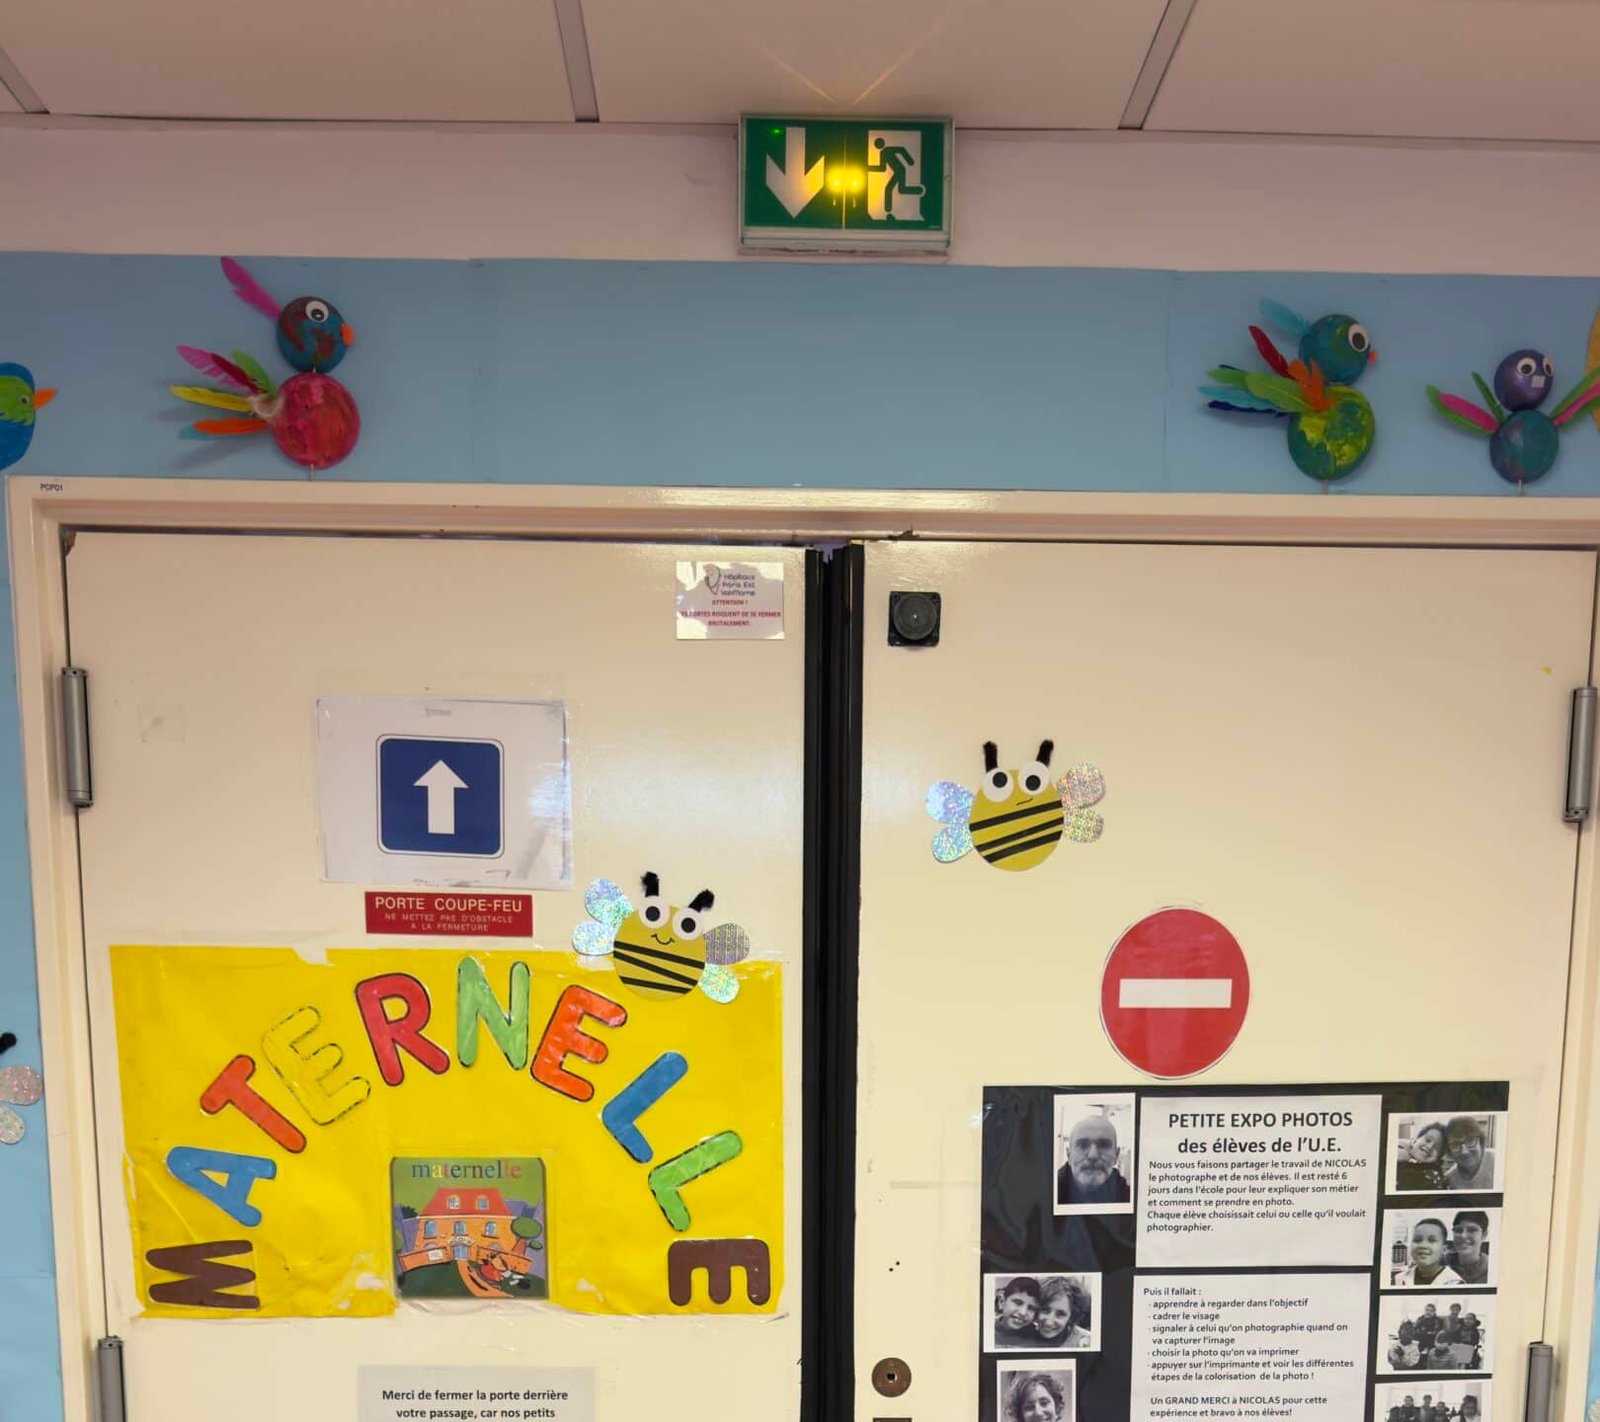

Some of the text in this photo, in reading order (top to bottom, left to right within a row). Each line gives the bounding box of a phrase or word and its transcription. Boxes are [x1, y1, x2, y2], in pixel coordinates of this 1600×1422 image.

[375, 896, 522, 912] PORTE COUPE-FEU
[384, 913, 513, 923] NE METTEZ PAS D'OBSTACLE
[422, 923, 432, 931] LA
[437, 923, 489, 932] FERMETURE
[1168, 1111, 1353, 1128] PETITE EXPO PHOTOS
[146, 956, 771, 1309] MATERNELLE
[1178, 1136, 1342, 1154] des élèves de l'U.E.
[411, 1159, 522, 1179] maternelle
[1149, 1160, 1173, 1169] Nous
[1197, 1160, 1229, 1169] faisons
[1230, 1160, 1270, 1171] partager
[1271, 1160, 1280, 1168] le
[1282, 1159, 1310, 1168] travail
[1312, 1159, 1323, 1168] de
[1324, 1158, 1367, 1168] NICOLAS
[1148, 1172, 1157, 1181] le
[1159, 1172, 1217, 1183] photographe
[1218, 1173, 1228, 1181] et
[1230, 1172, 1241, 1181] de
[1261, 1172, 1291, 1181] élèves.
[1317, 1172, 1340, 1180] resté
[1341, 1172, 1348, 1180] 6
[1147, 1186, 1170, 1196] jours
[1172, 1185, 1194, 1194] dans
[1195, 1185, 1224, 1194] l'école
[1226, 1186, 1247, 1195] pour
[1249, 1185, 1266, 1194] leur
[1268, 1184, 1310, 1195] expliquer
[1329, 1184, 1359, 1192] métier
[1147, 1199, 1157, 1207] et
[1159, 1199, 1202, 1207] comment
[1215, 1198, 1251, 1208] prendre
[1265, 1198, 1294, 1208] photo.
[1147, 1210, 1181, 1220] Chaque
[1183, 1210, 1206, 1219] élève
[1208, 1210, 1254, 1219] choisissait
[1256, 1209, 1277, 1218] celui
[1291, 1209, 1313, 1218] celle
[1335, 1209, 1366, 1218] voulait
[1147, 1222, 1214, 1233] photographier.
[1143, 1287, 1162, 1296] Puis
[1171, 1287, 1197, 1296] fallait
[1153, 1299, 1199, 1309] apprendre
[1207, 1299, 1245, 1310] regarder
[1247, 1299, 1268, 1308] dans
[1152, 1312, 1220, 1321] cadrer le visage
[1152, 1324, 1187, 1334] signaler
[1196, 1324, 1216, 1332] celui
[1244, 1323, 1305, 1333] photographie
[1306, 1323, 1335, 1333] quand
[1164, 1337, 1201, 1346] capturer
[1151, 1348, 1181, 1357] choisir
[1182, 1348, 1190, 1356] la
[1192, 1348, 1218, 1358] photo
[1259, 1347, 1300, 1357] imprimer
[1151, 1362, 1187, 1371] appuyer
[1273, 1360, 1290, 1368] voir
[1292, 1360, 1304, 1368] les
[1305, 1359, 1354, 1368] différentes
[1151, 1372, 1180, 1382] étapes
[1182, 1372, 1193, 1381] de
[1195, 1372, 1203, 1380] la
[1204, 1372, 1256, 1381] colorisation
[1260, 1372, 1271, 1380] de
[1273, 1372, 1281, 1380] la
[1282, 1372, 1309, 1381] photo
[382, 1389, 568, 1403] Merci de fermer la porte derrière
[1150, 1397, 1163, 1405] Un
[1165, 1396, 1199, 1405] GRAND
[1201, 1396, 1230, 1405] MERCI
[1239, 1396, 1281, 1404] NICOLAS
[1282, 1397, 1303, 1406] pour
[1304, 1396, 1328, 1404] cette
[396, 1407, 556, 1420] votre passage, car nos petits
[1150, 1408, 1198, 1418] expérience
[1199, 1409, 1208, 1417] et
[1210, 1408, 1236, 1417] bravo
[1262, 1407, 1293, 1416] élèves!
